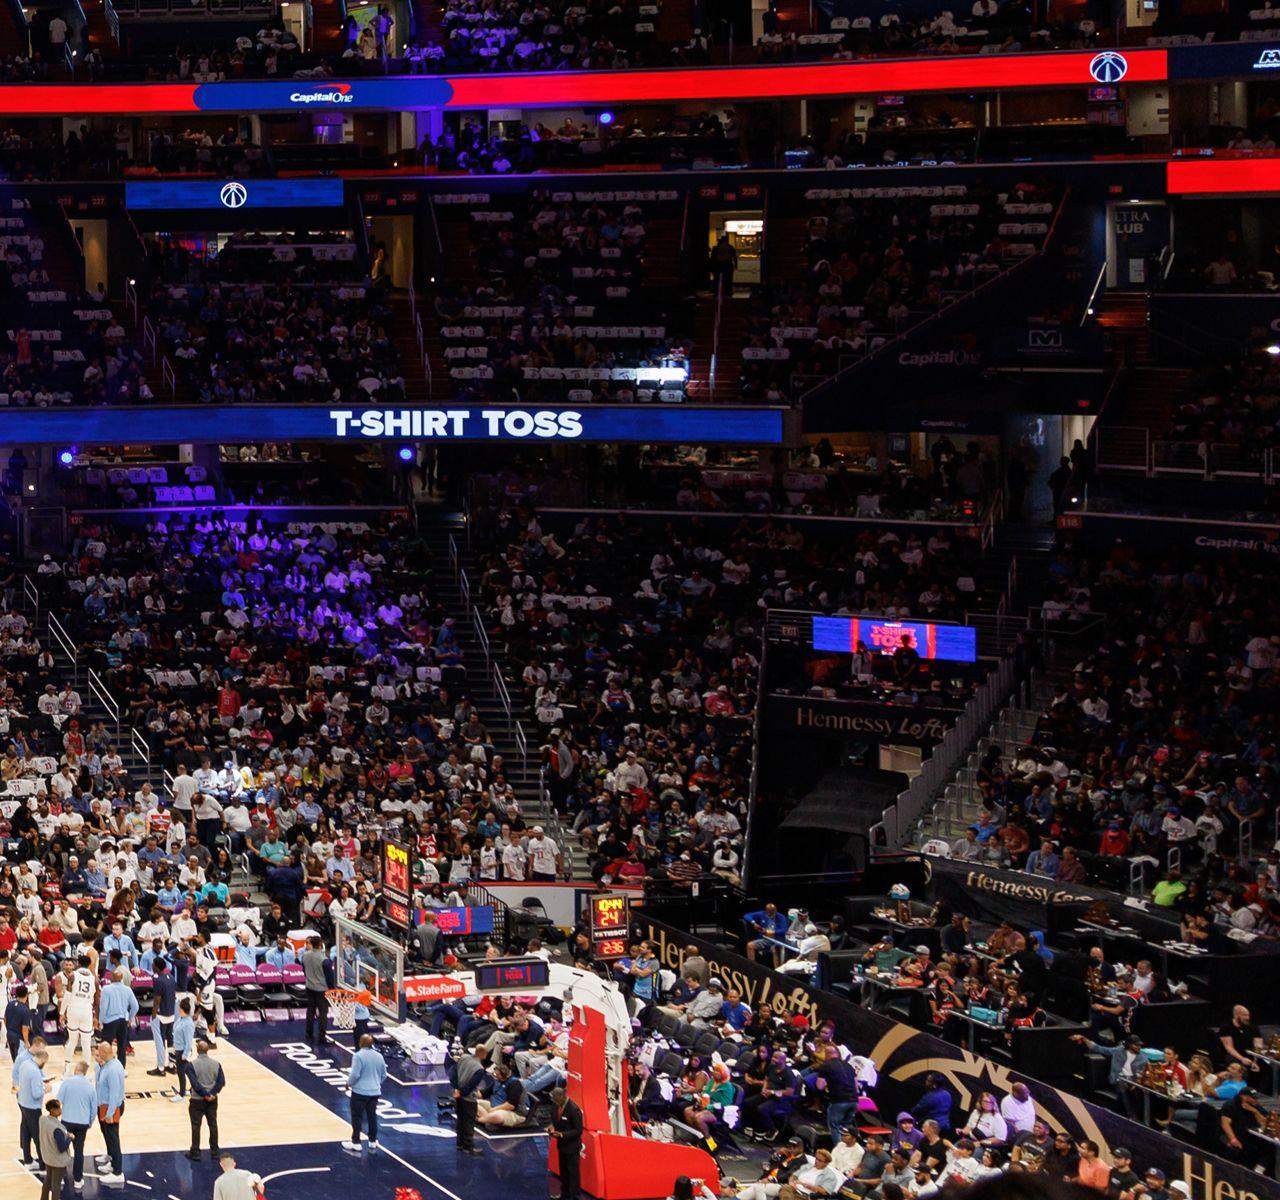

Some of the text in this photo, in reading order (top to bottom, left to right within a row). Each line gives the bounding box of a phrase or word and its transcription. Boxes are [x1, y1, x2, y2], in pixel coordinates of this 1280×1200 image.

[330, 410, 583, 438] T-SHIRT TOSS
[796, 706, 895, 736] Hennessy
[966, 871, 1053, 905] Hennessy
[601, 911, 619, 926] 24
[603, 941, 624, 954] 2:36
[78, 980, 90, 993] 13
